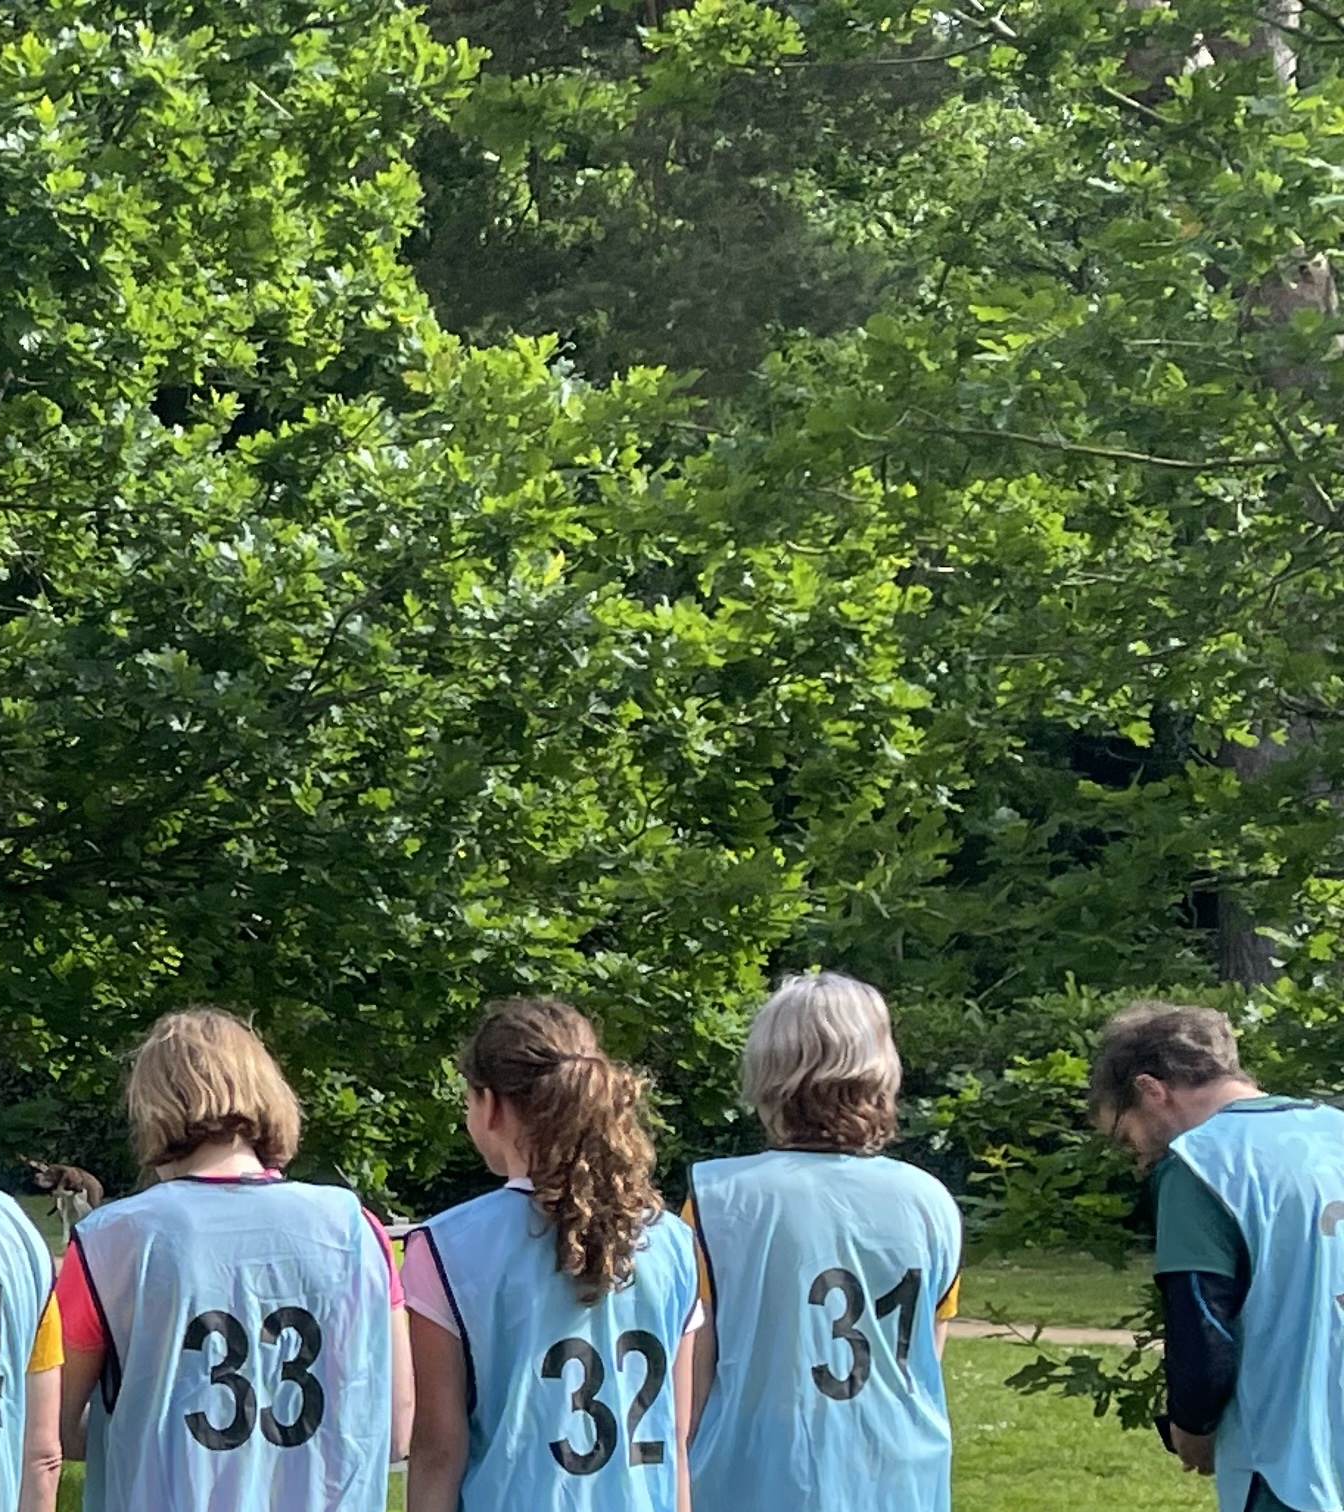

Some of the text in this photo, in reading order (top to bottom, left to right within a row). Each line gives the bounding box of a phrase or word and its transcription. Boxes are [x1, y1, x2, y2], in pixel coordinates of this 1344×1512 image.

[183, 1306, 325, 1451] 33
[541, 1330, 667, 1476] 32
[807, 1267, 922, 1401] 31
